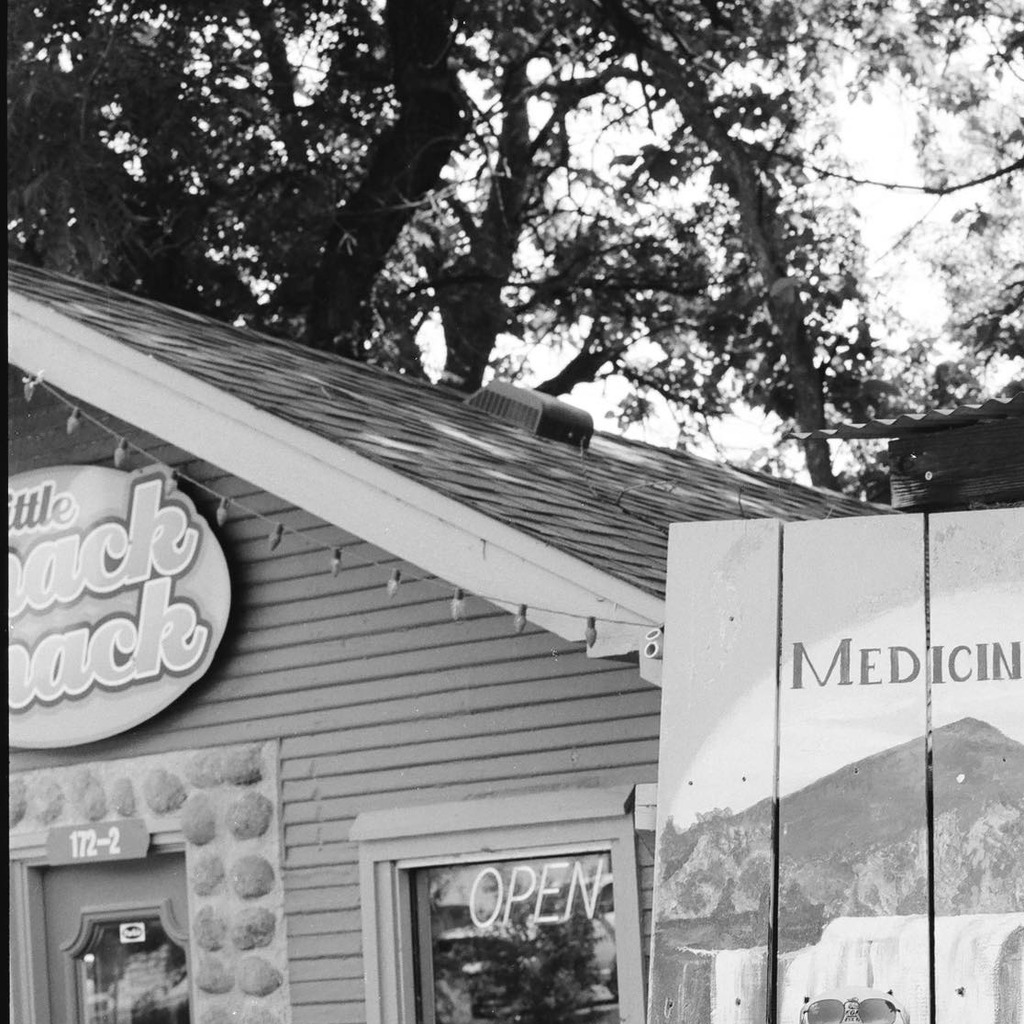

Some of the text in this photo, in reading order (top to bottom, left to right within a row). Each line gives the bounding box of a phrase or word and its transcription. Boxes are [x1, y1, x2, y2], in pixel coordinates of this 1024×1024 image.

[9, 482, 78, 533] ttle
[69, 826, 121, 858] 172-2
[469, 858, 604, 928] OPEN
